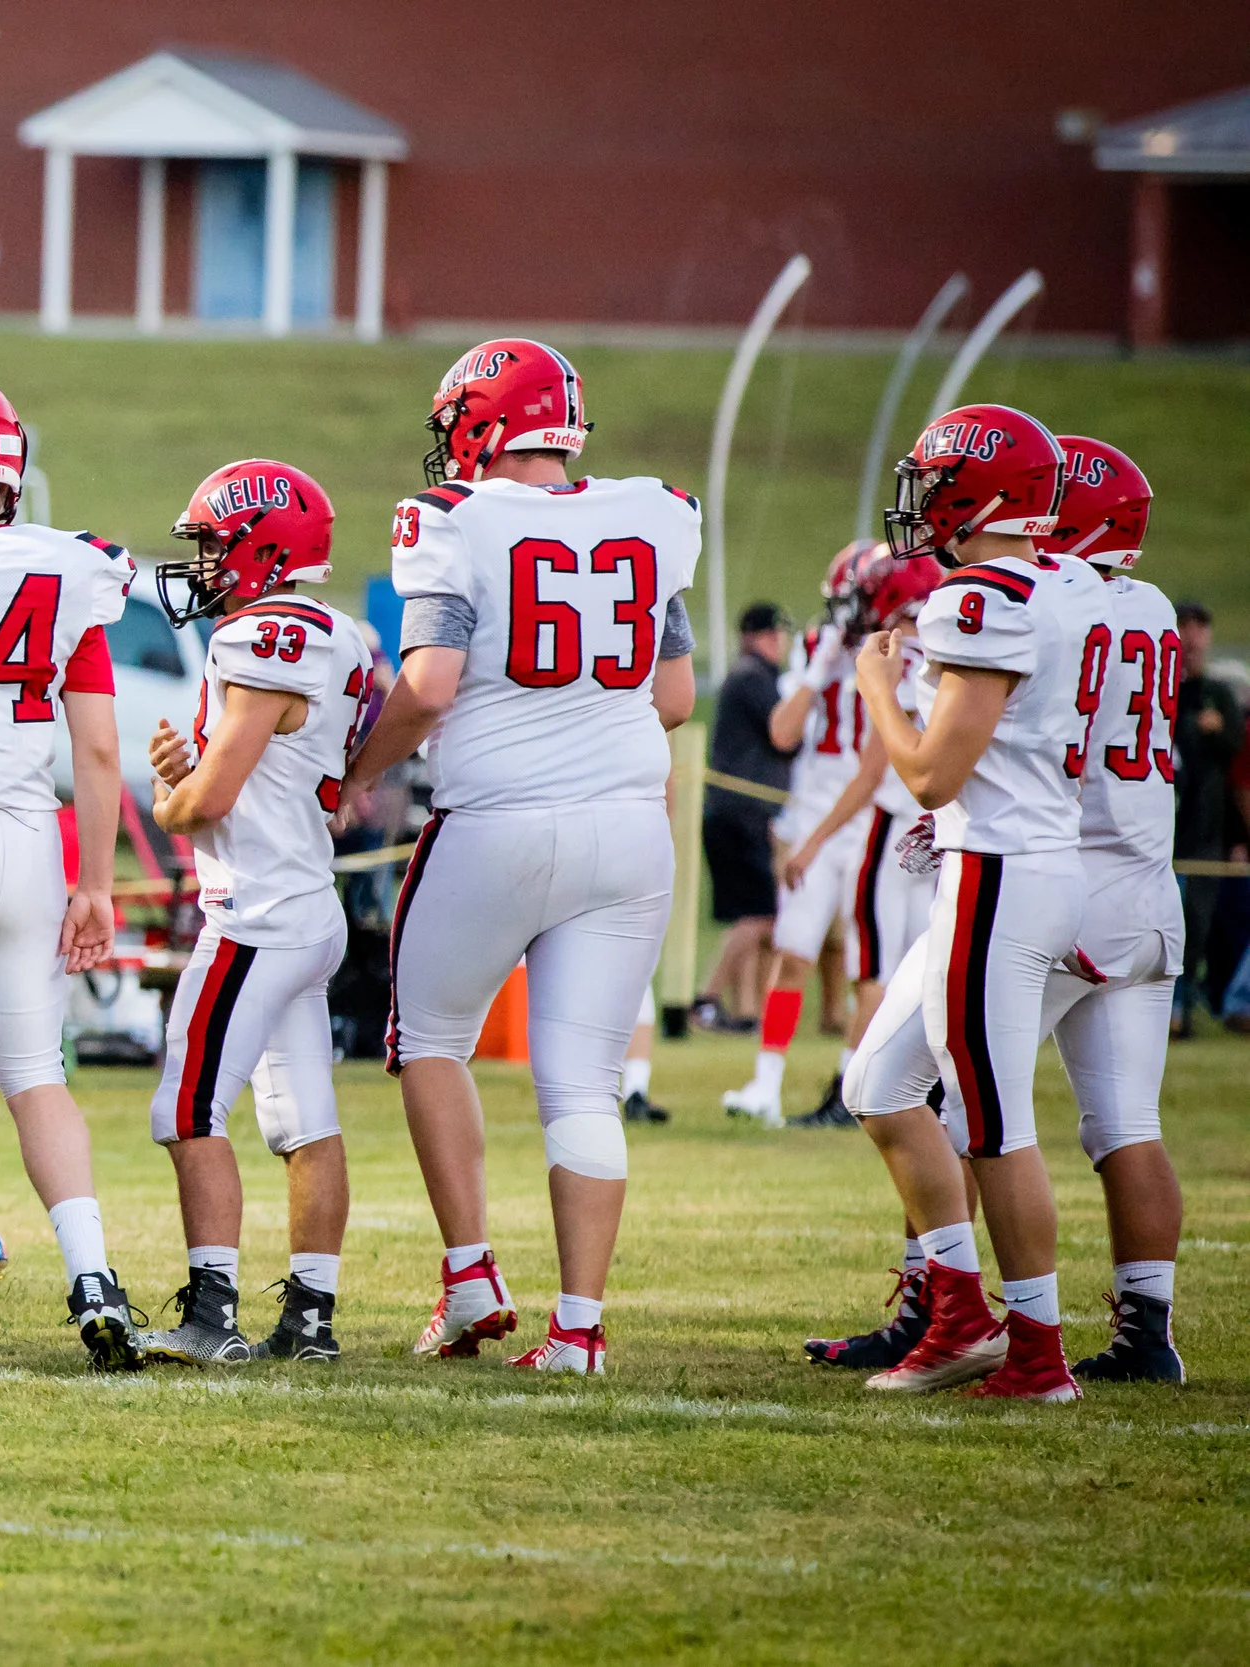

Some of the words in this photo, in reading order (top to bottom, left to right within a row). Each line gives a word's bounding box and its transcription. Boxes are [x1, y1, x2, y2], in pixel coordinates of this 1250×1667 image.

[923, 423, 1004, 462] WELLS
[204, 476, 291, 522] WELLS
[505, 536, 658, 690] 63
[957, 591, 986, 634] 9
[251, 620, 307, 663] 33
[1062, 623, 1112, 780] 9
[1104, 629, 1182, 784] 39
[81, 1276, 105, 1304] NIKE
